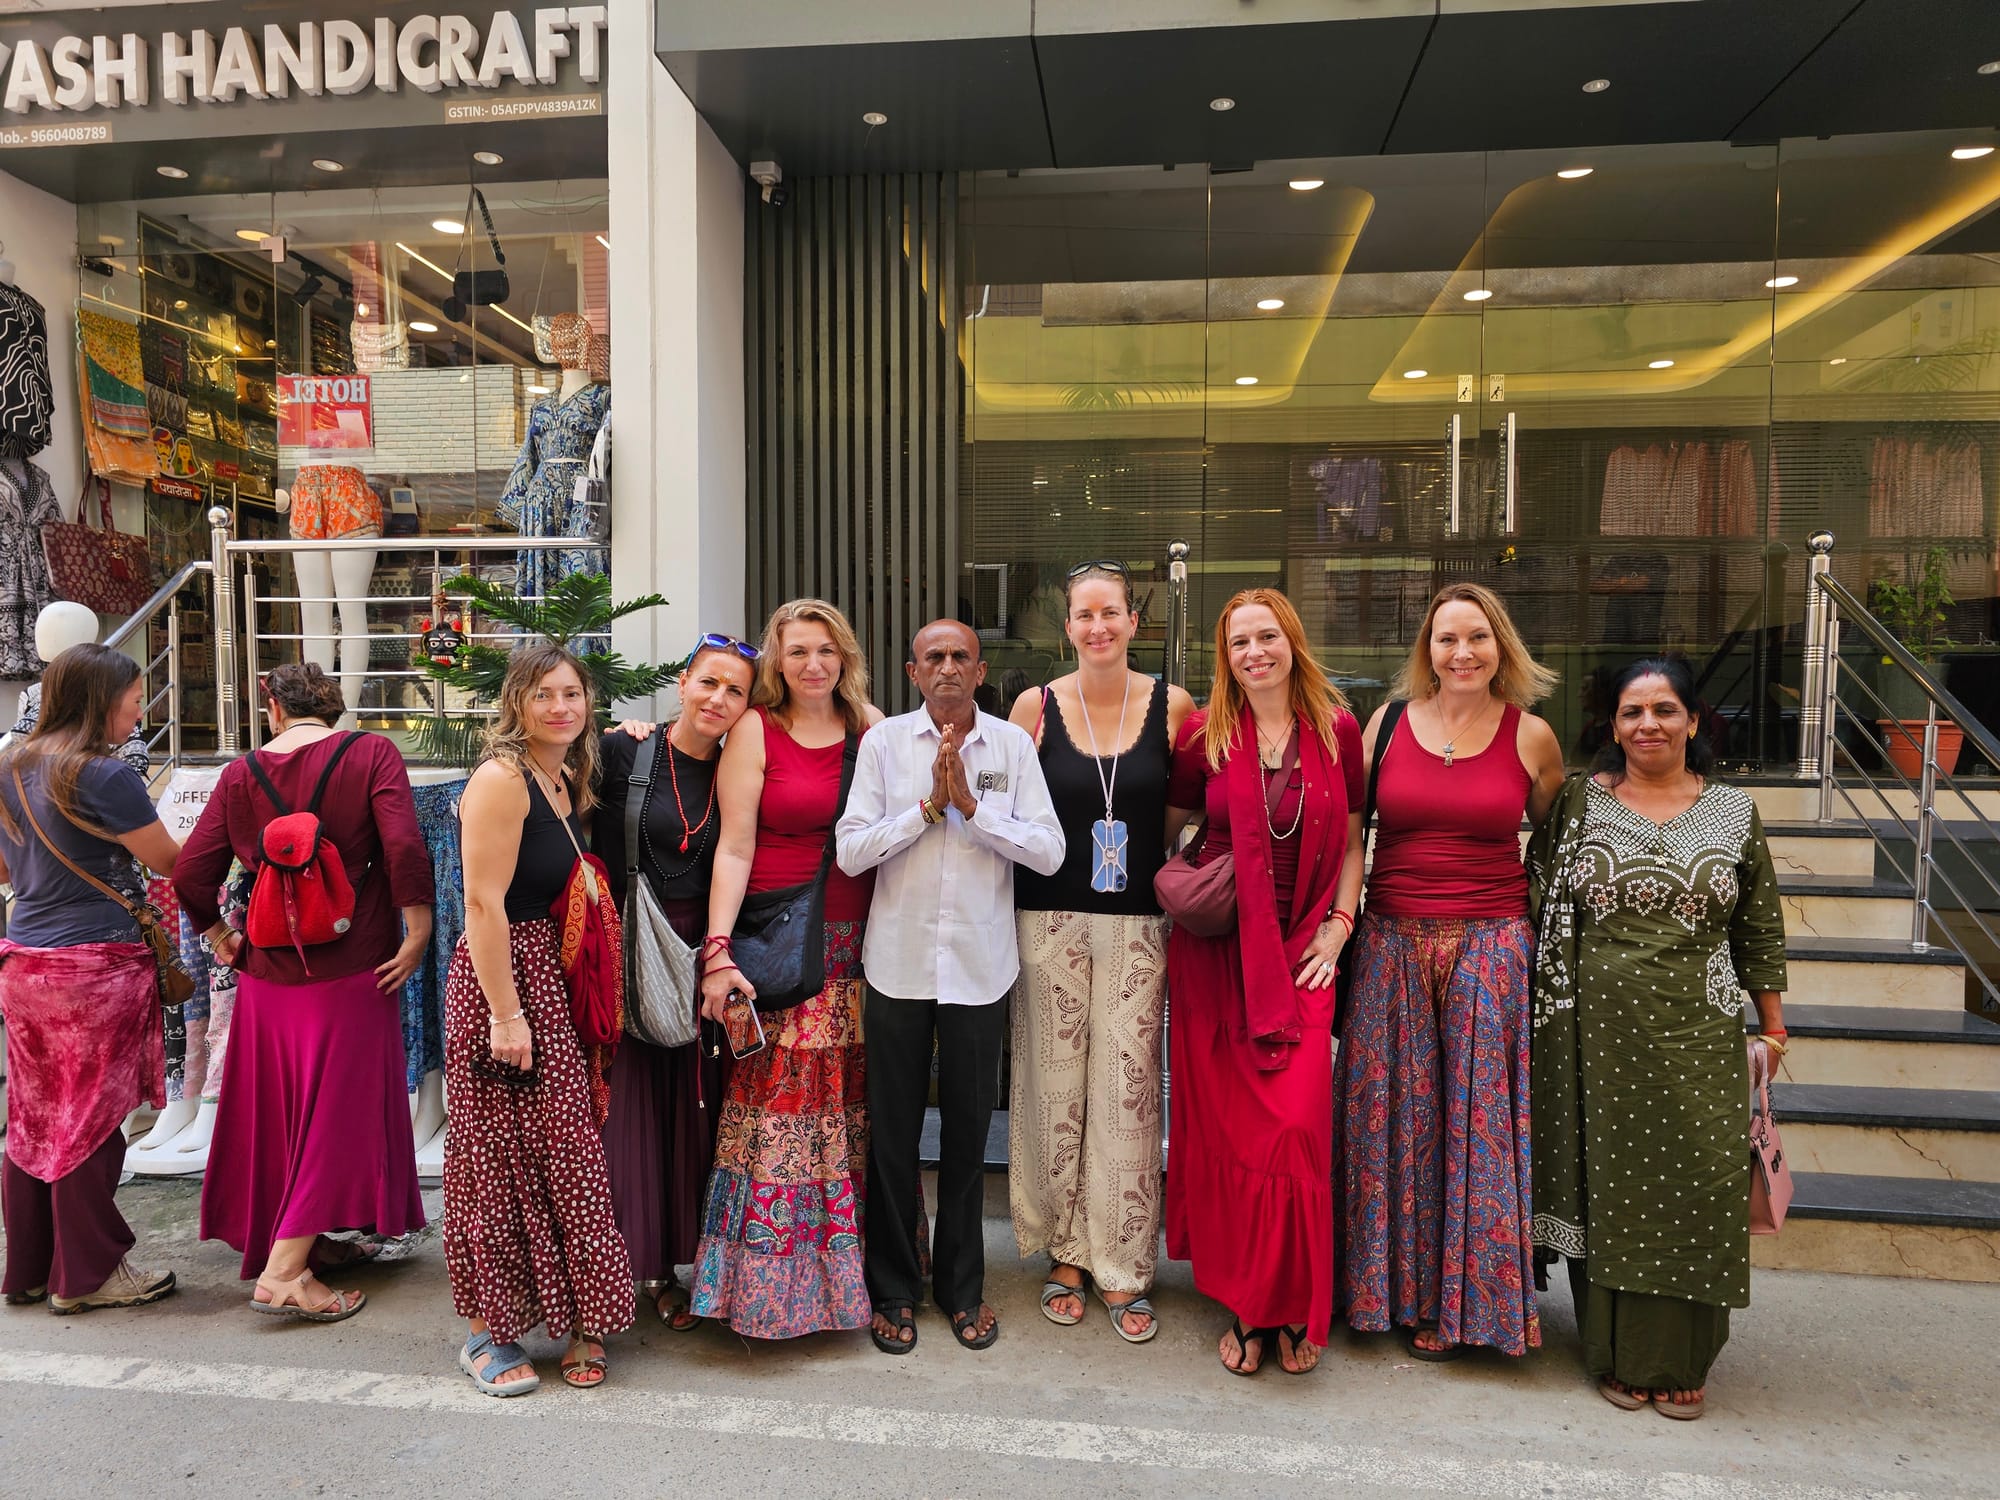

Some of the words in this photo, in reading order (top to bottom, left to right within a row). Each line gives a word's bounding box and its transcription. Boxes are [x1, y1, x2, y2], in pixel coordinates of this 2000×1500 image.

[0, 33, 149, 114] ASH
[162, 6, 608, 105] HANDICRAFT
[449, 105, 489, 118] GSTIN:-
[491, 99, 597, 116] 05AFDPV4839A1ZK
[31, 126, 107, 143] 9660408789
